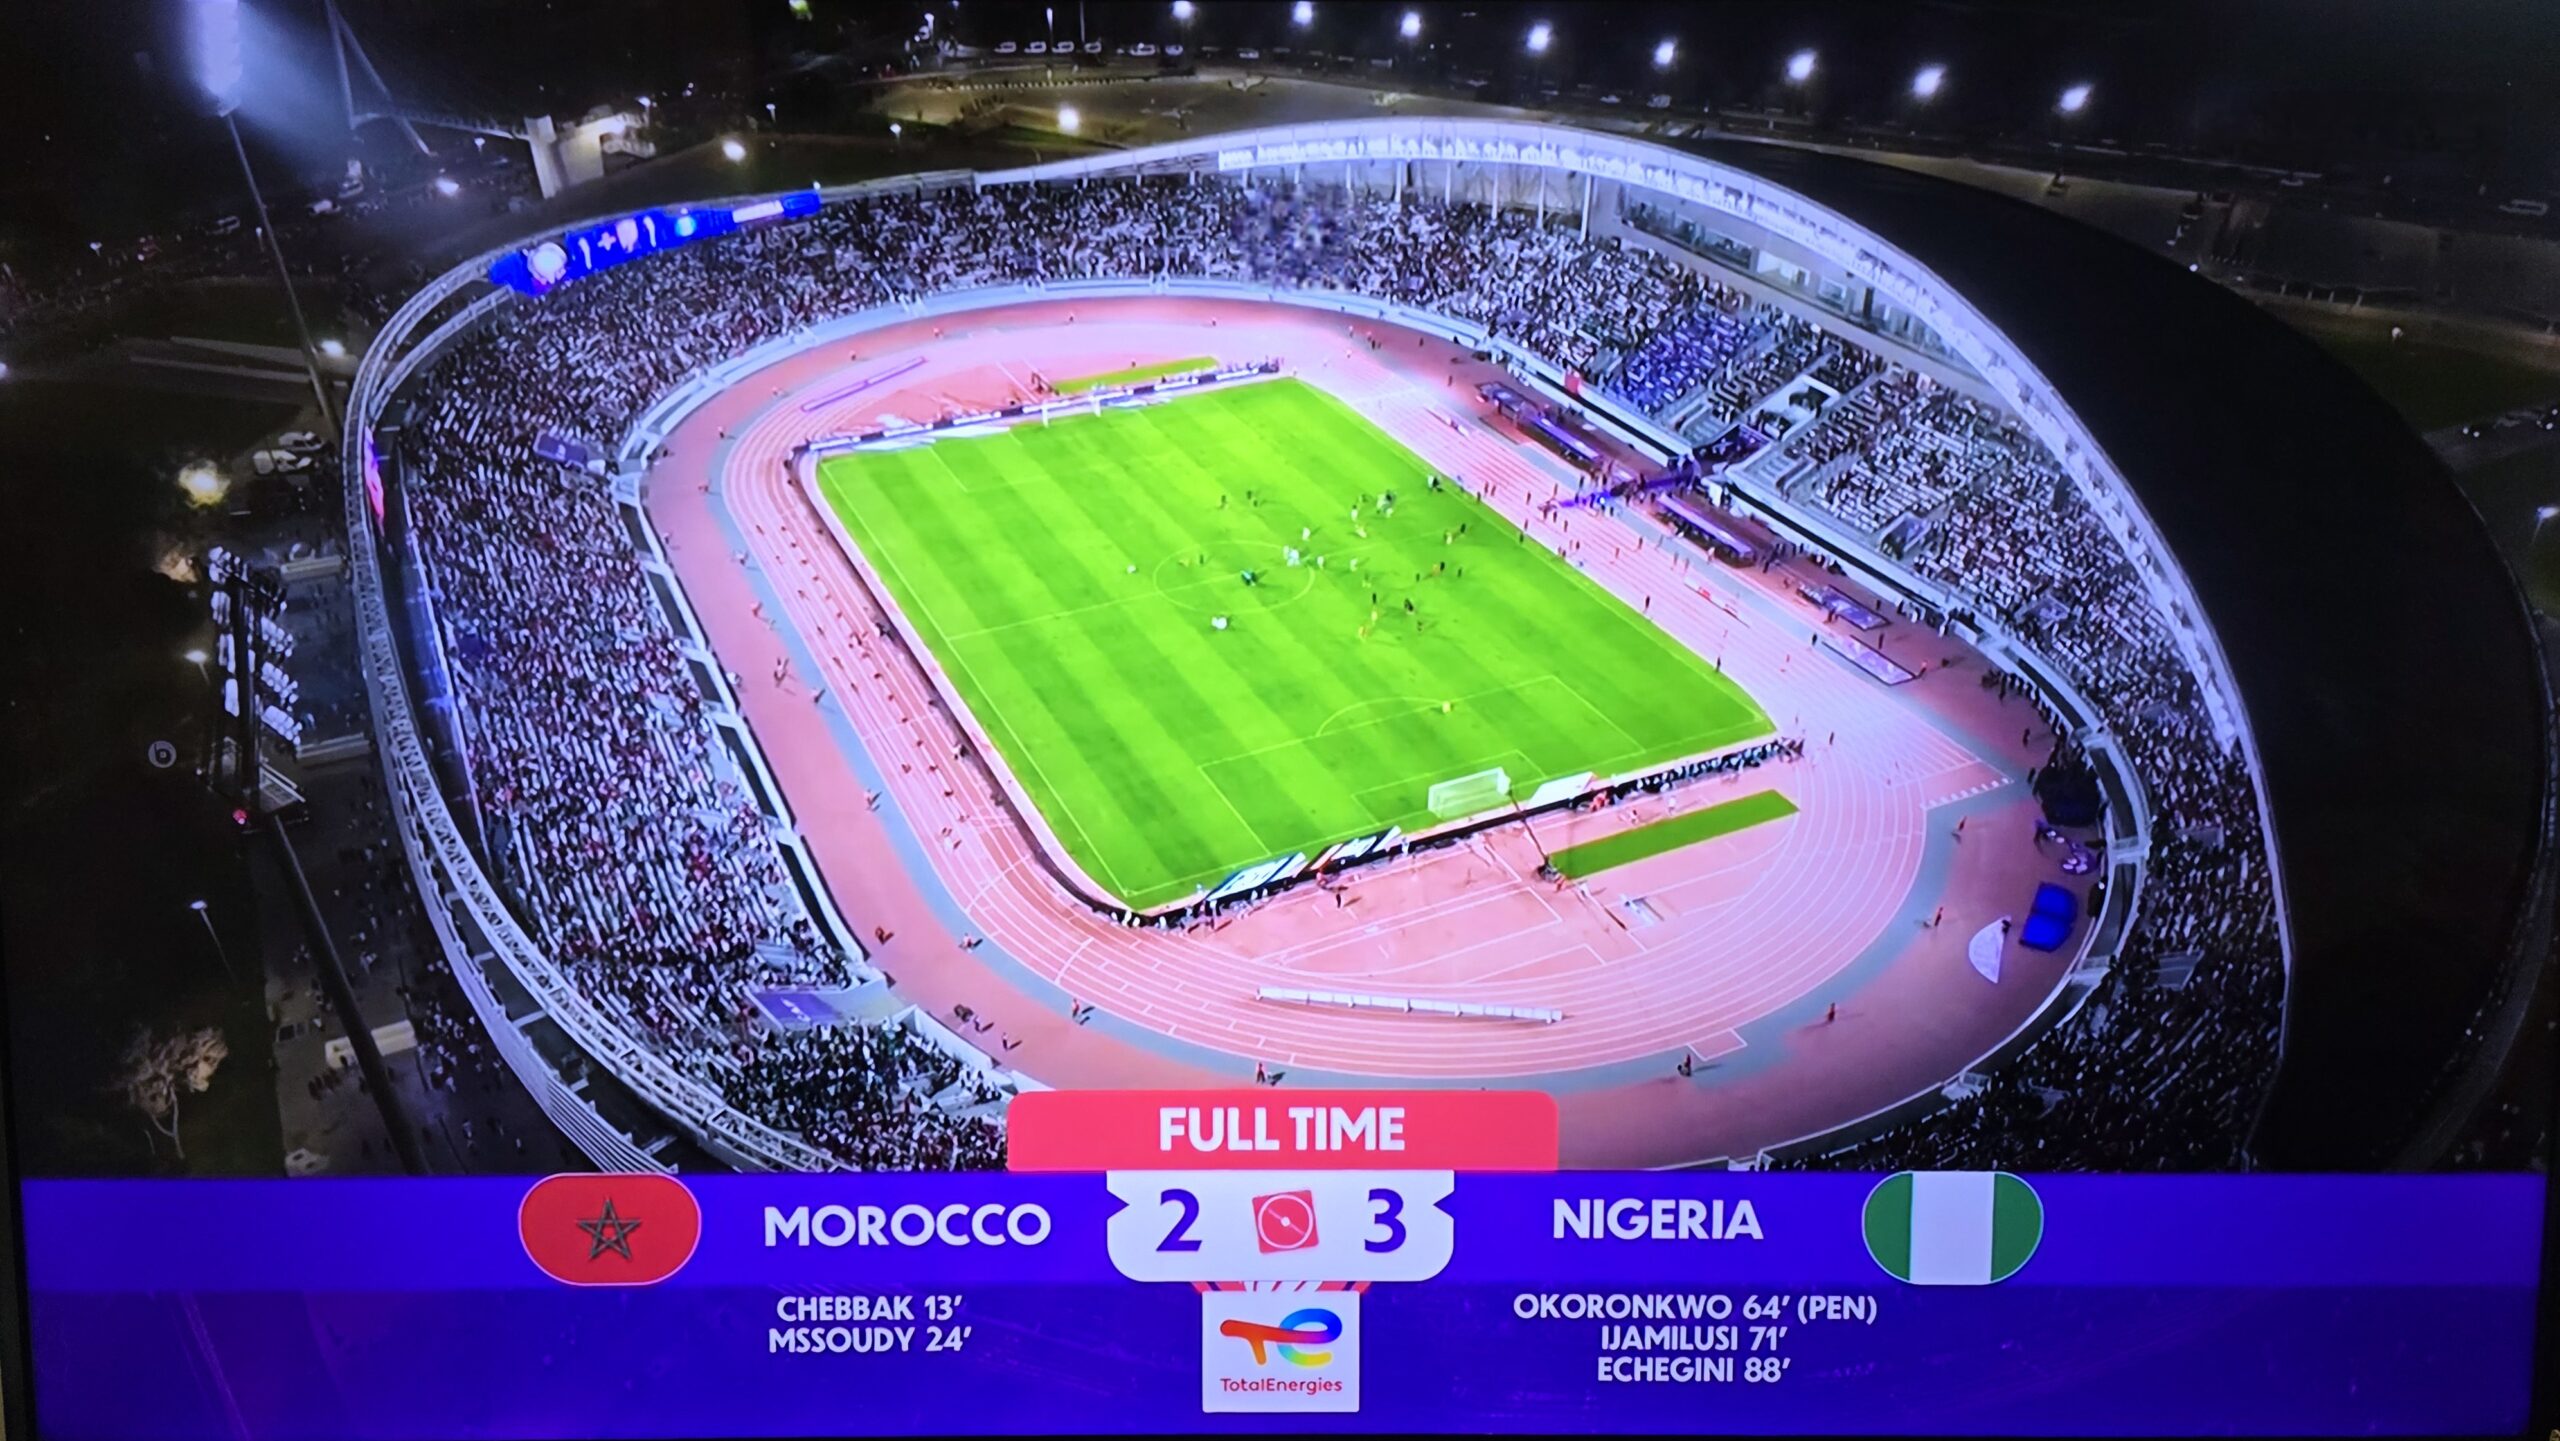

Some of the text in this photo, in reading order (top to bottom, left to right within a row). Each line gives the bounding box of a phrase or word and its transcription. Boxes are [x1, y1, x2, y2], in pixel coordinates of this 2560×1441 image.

[1159, 1107, 1406, 1152] FULL TIME
[764, 1203, 1051, 1247] MOROCCO
[1155, 1188, 1203, 1252] 2
[1364, 1188, 1407, 1254] 3
[1553, 1198, 1764, 1240] NIGERIA
[776, 1295, 915, 1322] CHEBBAK
[1513, 1293, 1733, 1320] OKORONKWO
[1797, 1294, 1877, 1325] (PEN)
[768, 1326, 916, 1353] MSSOUDY
[1601, 1325, 1738, 1351] IJAMILUSI
[1597, 1356, 1734, 1382] ECHEGINI
[1220, 1377, 1343, 1396] TotalEnergies
